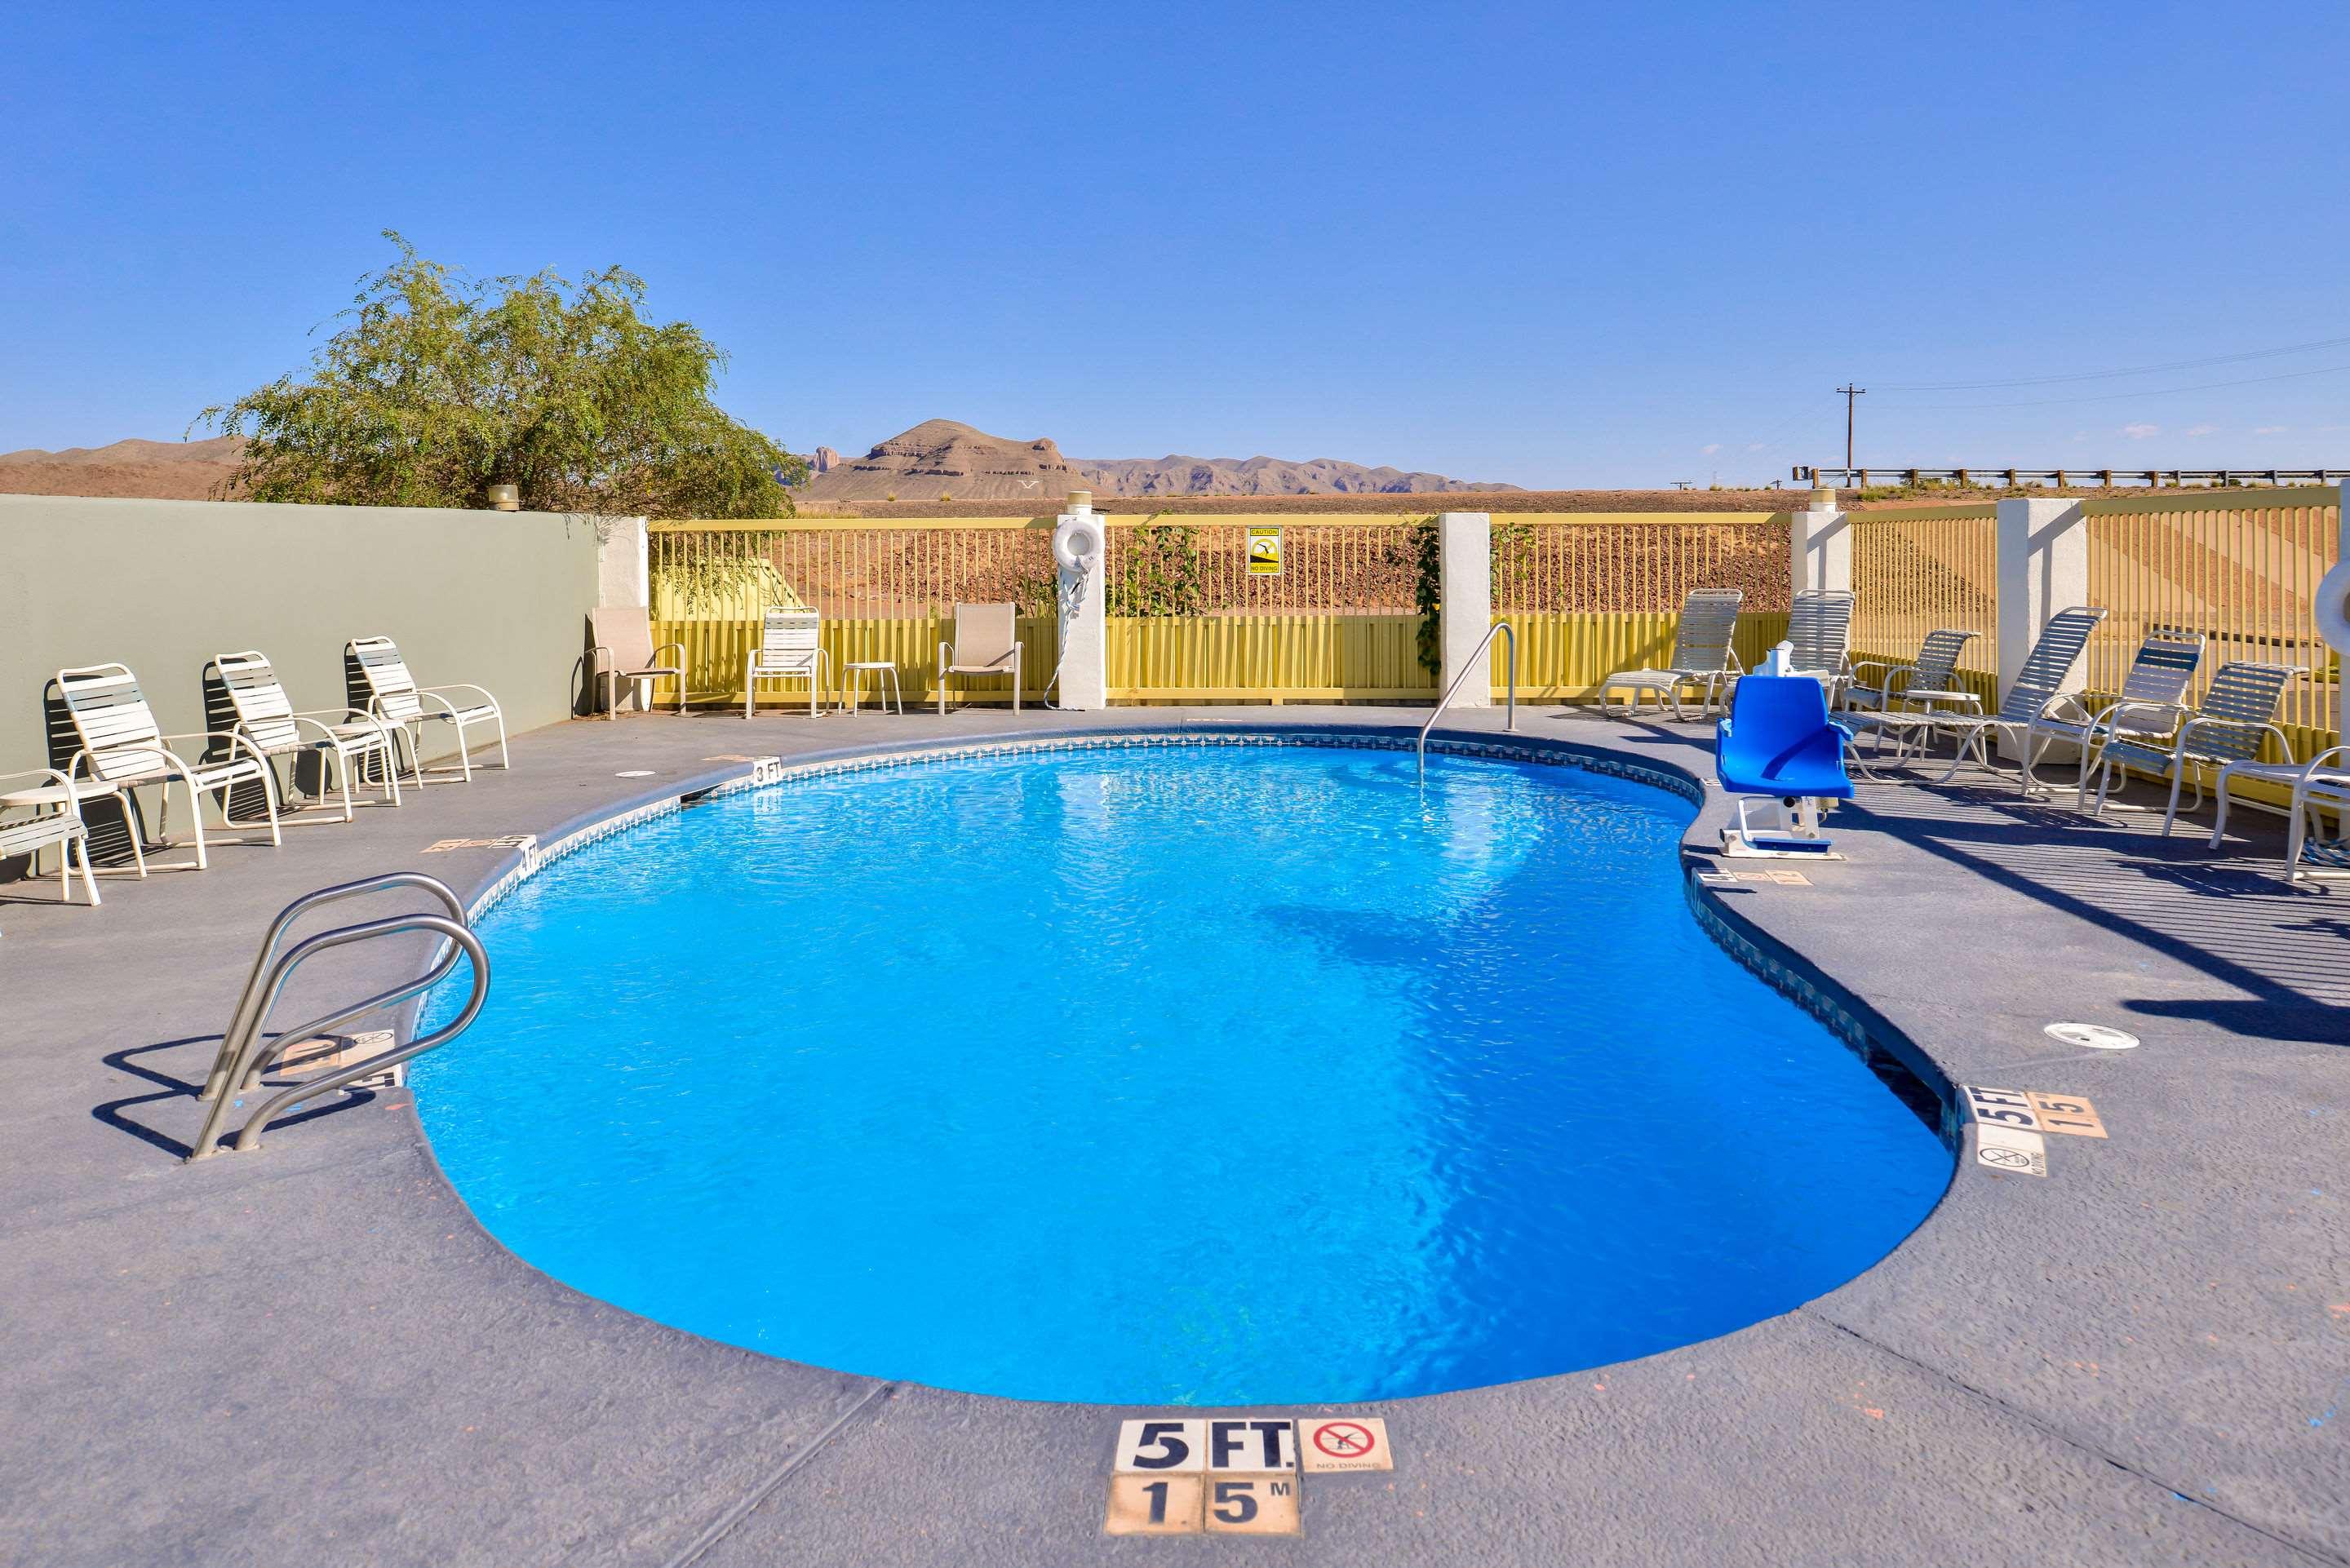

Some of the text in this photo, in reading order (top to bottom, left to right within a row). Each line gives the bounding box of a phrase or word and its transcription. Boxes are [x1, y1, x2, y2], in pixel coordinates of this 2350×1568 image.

[756, 761, 779, 782] 3 FT
[521, 843, 536, 872] 4 FT
[1976, 1108, 2033, 1126] 5
[1133, 1422, 1190, 1468] 5
